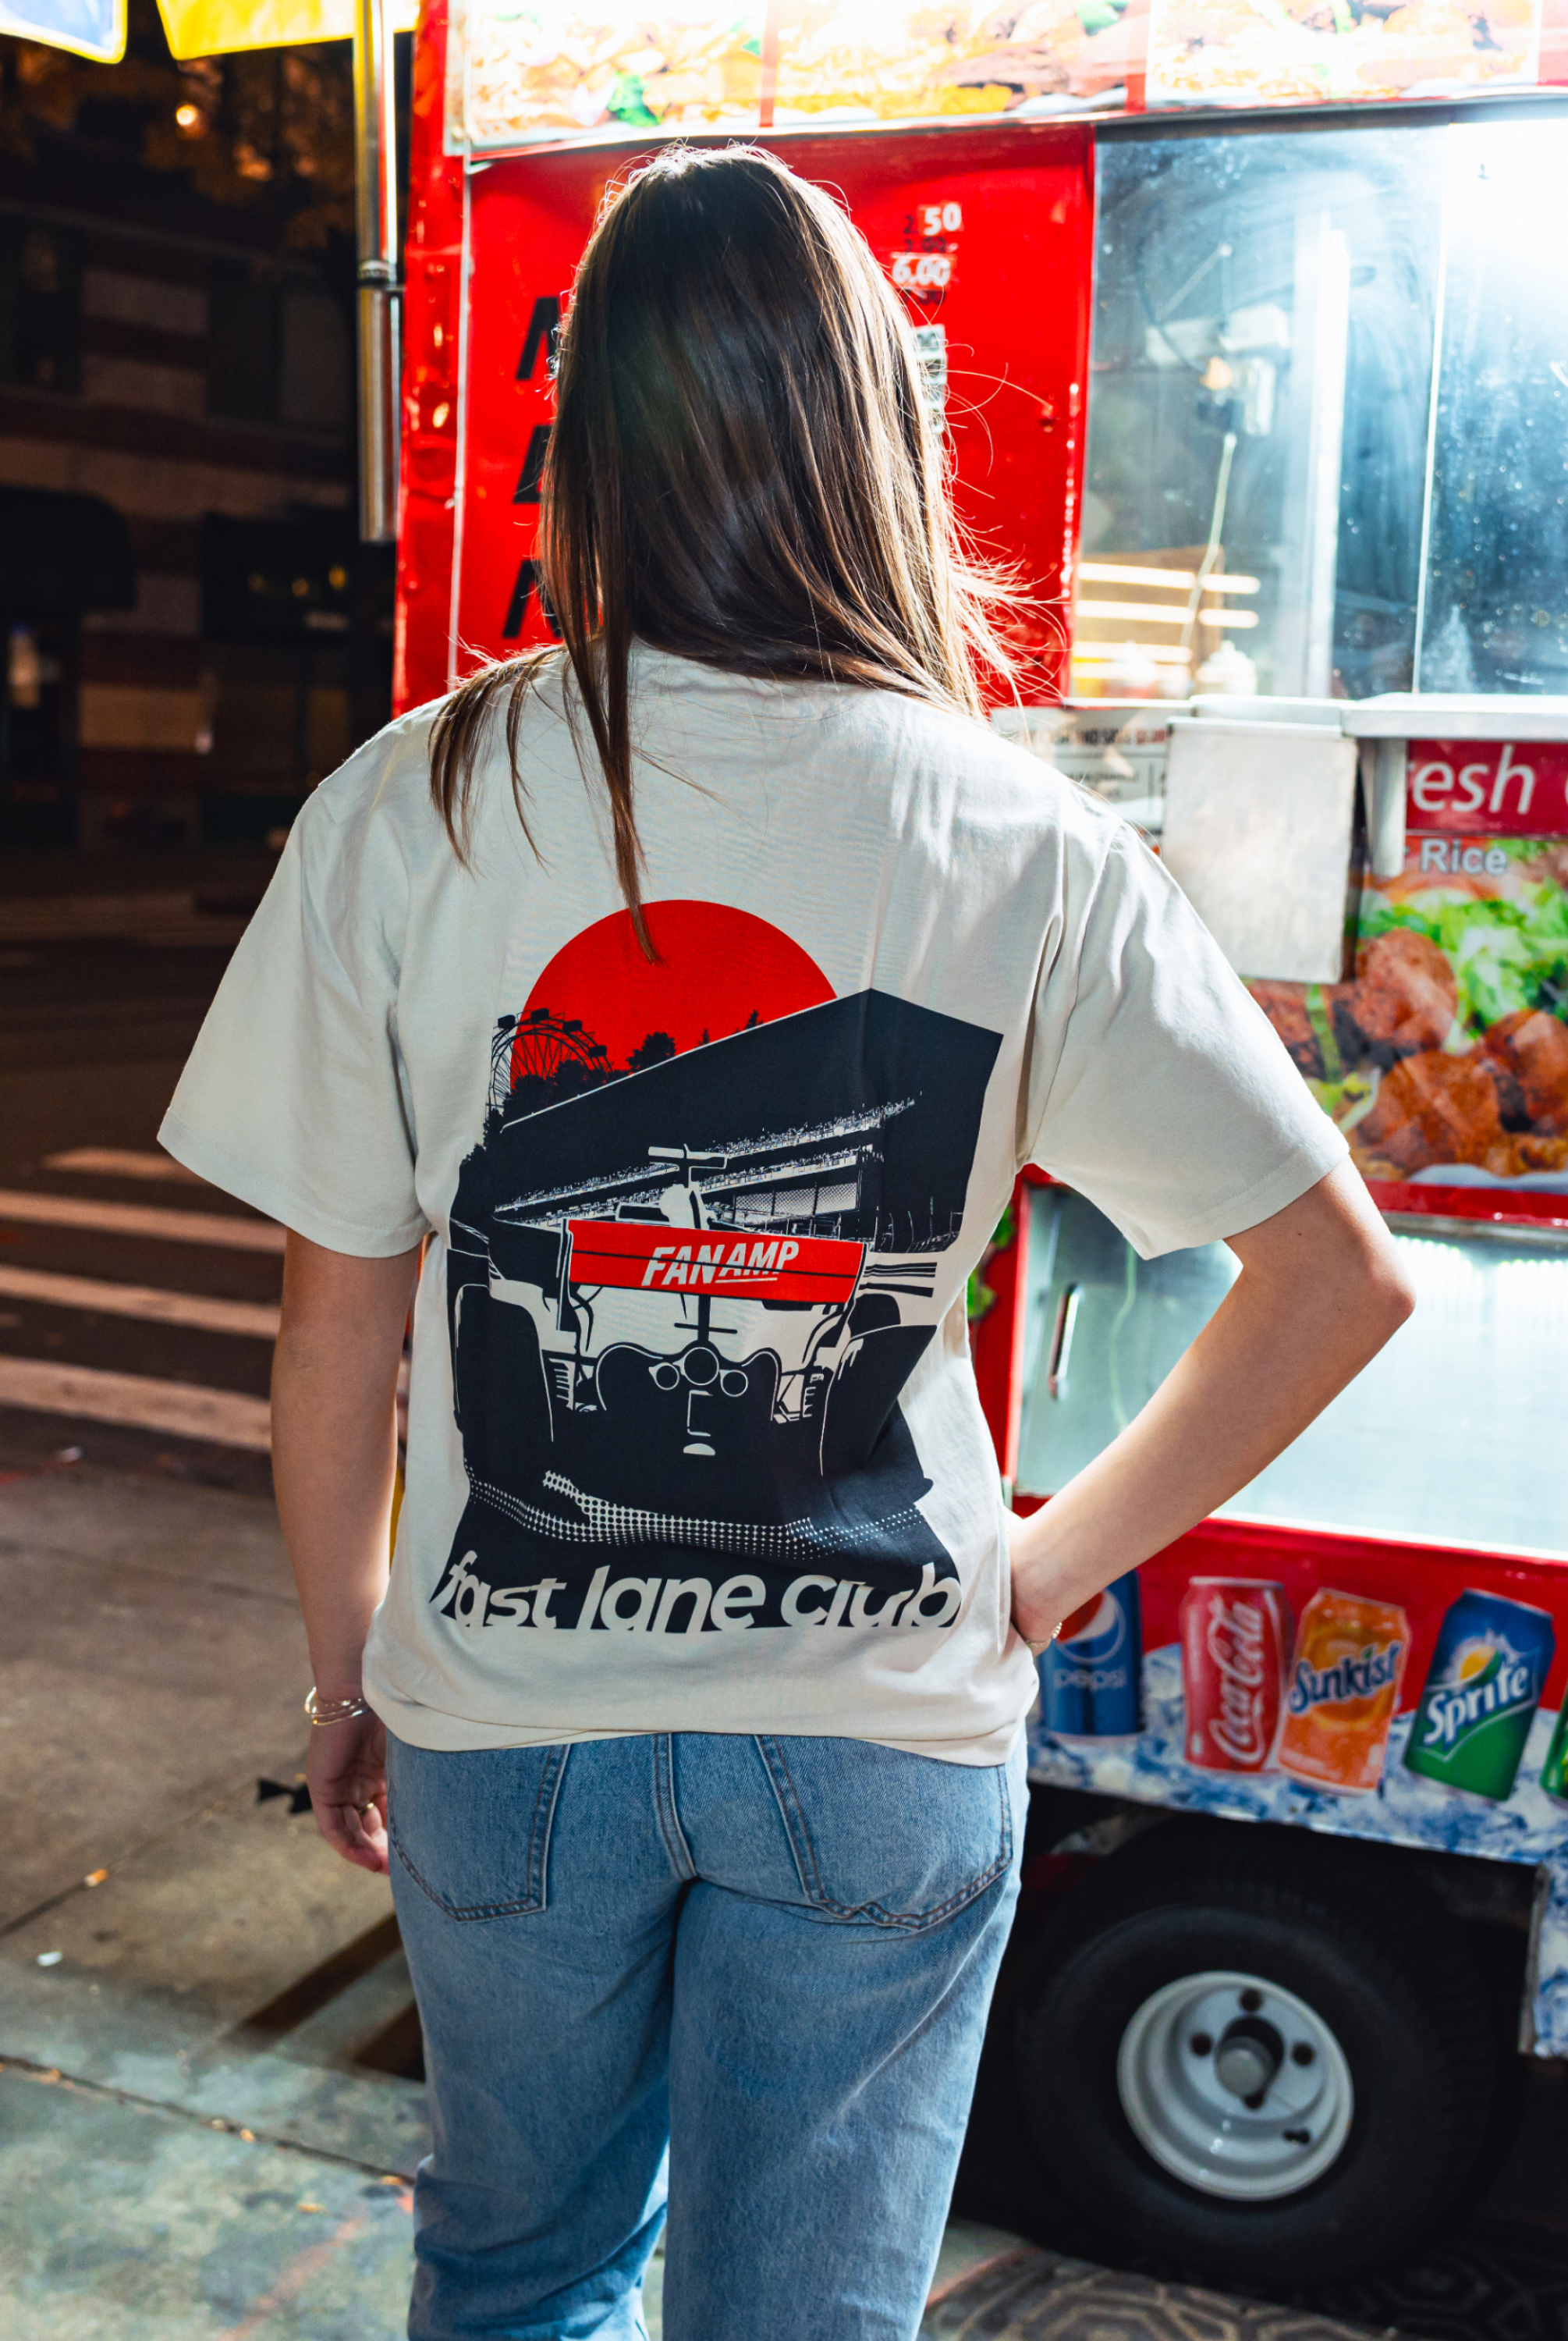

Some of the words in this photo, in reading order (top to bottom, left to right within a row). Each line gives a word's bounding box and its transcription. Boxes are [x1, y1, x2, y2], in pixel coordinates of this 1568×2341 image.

[1407, 744, 1535, 815] esh
[1421, 838, 1507, 876] Rice
[434, 1550, 568, 1629] fast
[575, 1564, 766, 1633] lane
[780, 1561, 963, 1629] club
[1289, 1639, 1403, 1714] Sunkist
[1422, 1656, 1530, 1748] Sprite
